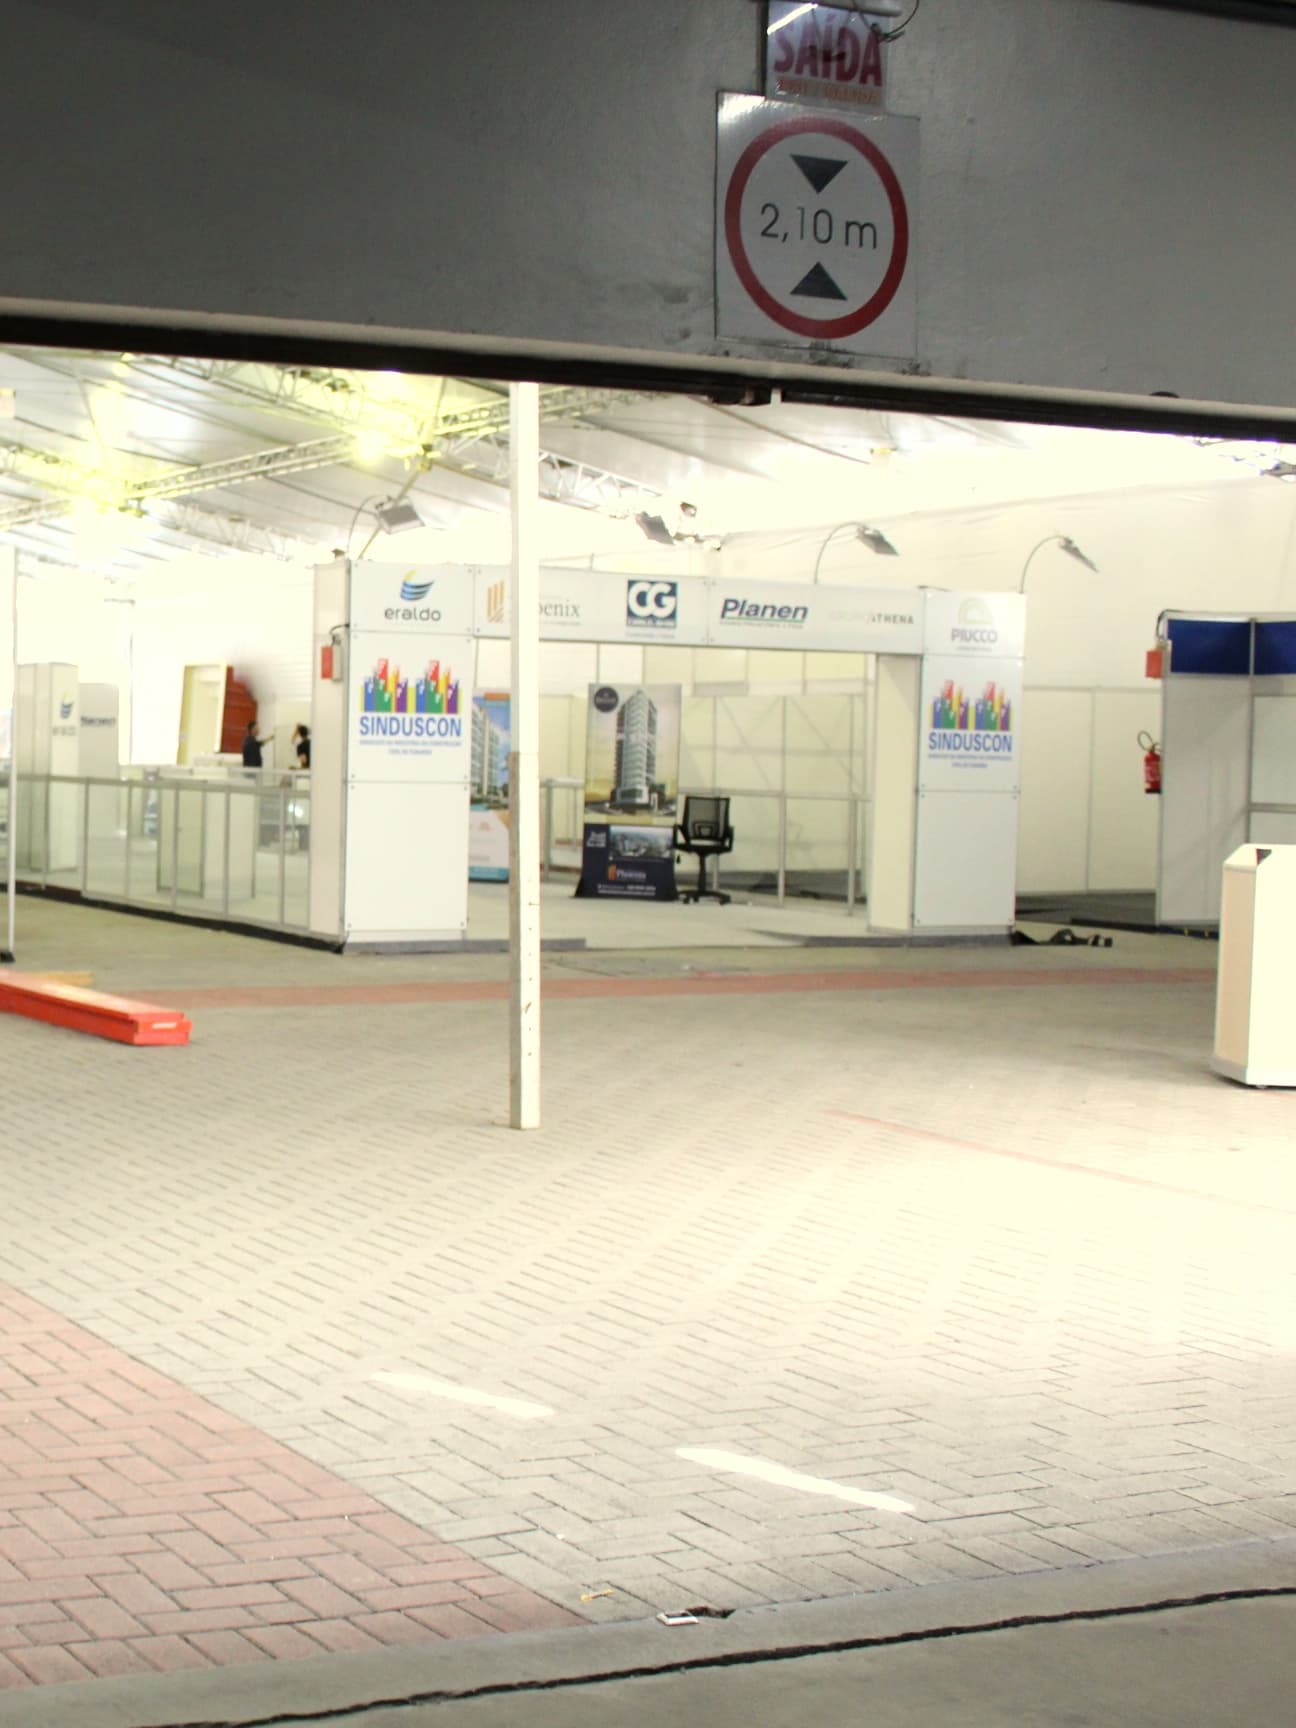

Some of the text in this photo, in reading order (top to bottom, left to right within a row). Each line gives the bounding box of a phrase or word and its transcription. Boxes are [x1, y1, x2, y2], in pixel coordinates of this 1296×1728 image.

[773, 14, 883, 88] SAÍDA
[760, 203, 878, 249] 2,10 m
[629, 582, 676, 619] CG
[720, 598, 809, 620] Planen
[384, 604, 442, 622] eraldo
[359, 715, 462, 737] SINDUSCON
[928, 732, 1013, 753] SINDUSCON
